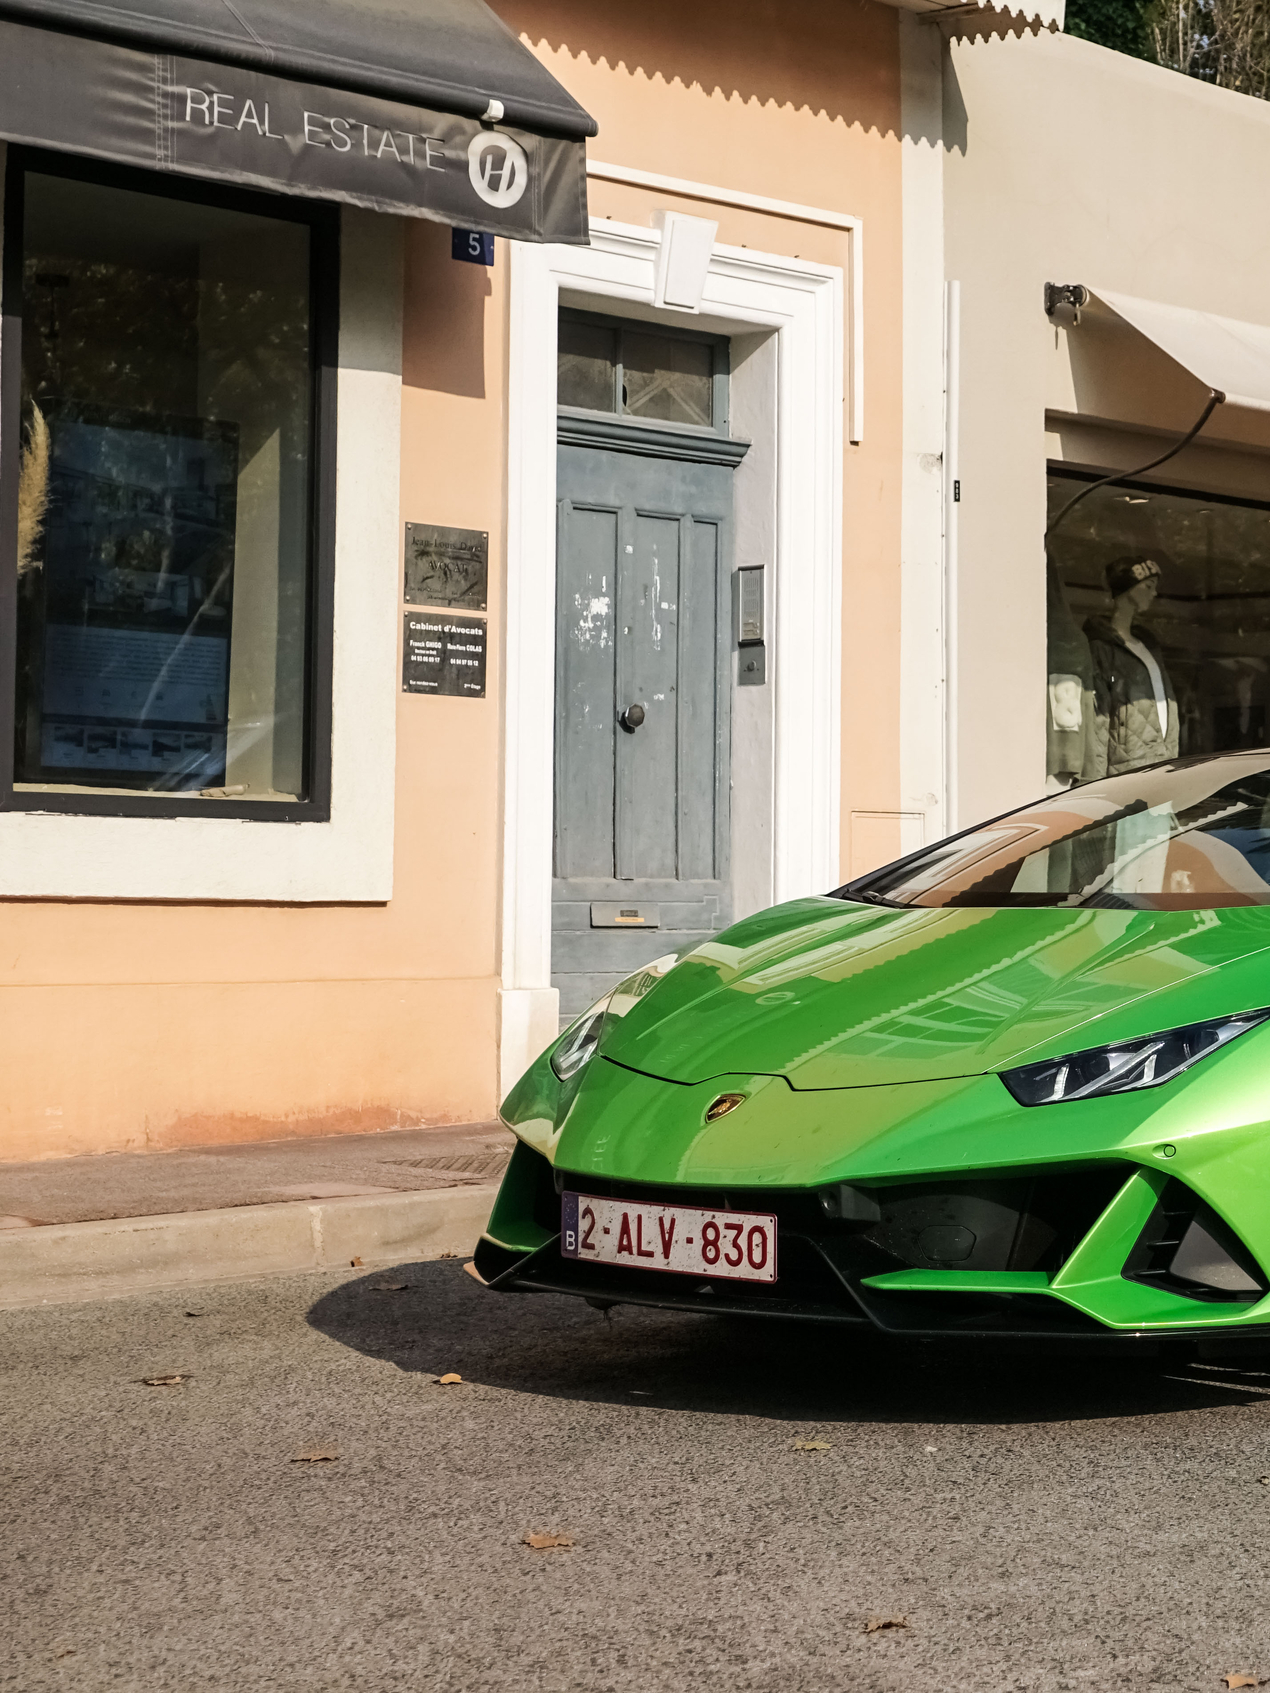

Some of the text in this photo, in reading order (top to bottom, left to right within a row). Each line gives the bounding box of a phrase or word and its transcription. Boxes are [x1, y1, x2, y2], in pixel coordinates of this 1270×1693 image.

[185, 87, 447, 172] REAL ESTATE
[467, 232, 481, 256] 5
[428, 560, 467, 574] AVOCAT
[409, 621, 483, 635] Cabinet d'Avocats
[466, 645, 483, 653] COLAS
[565, 1230, 576, 1250] B
[580, 1205, 768, 1270] 2-ALV-830
